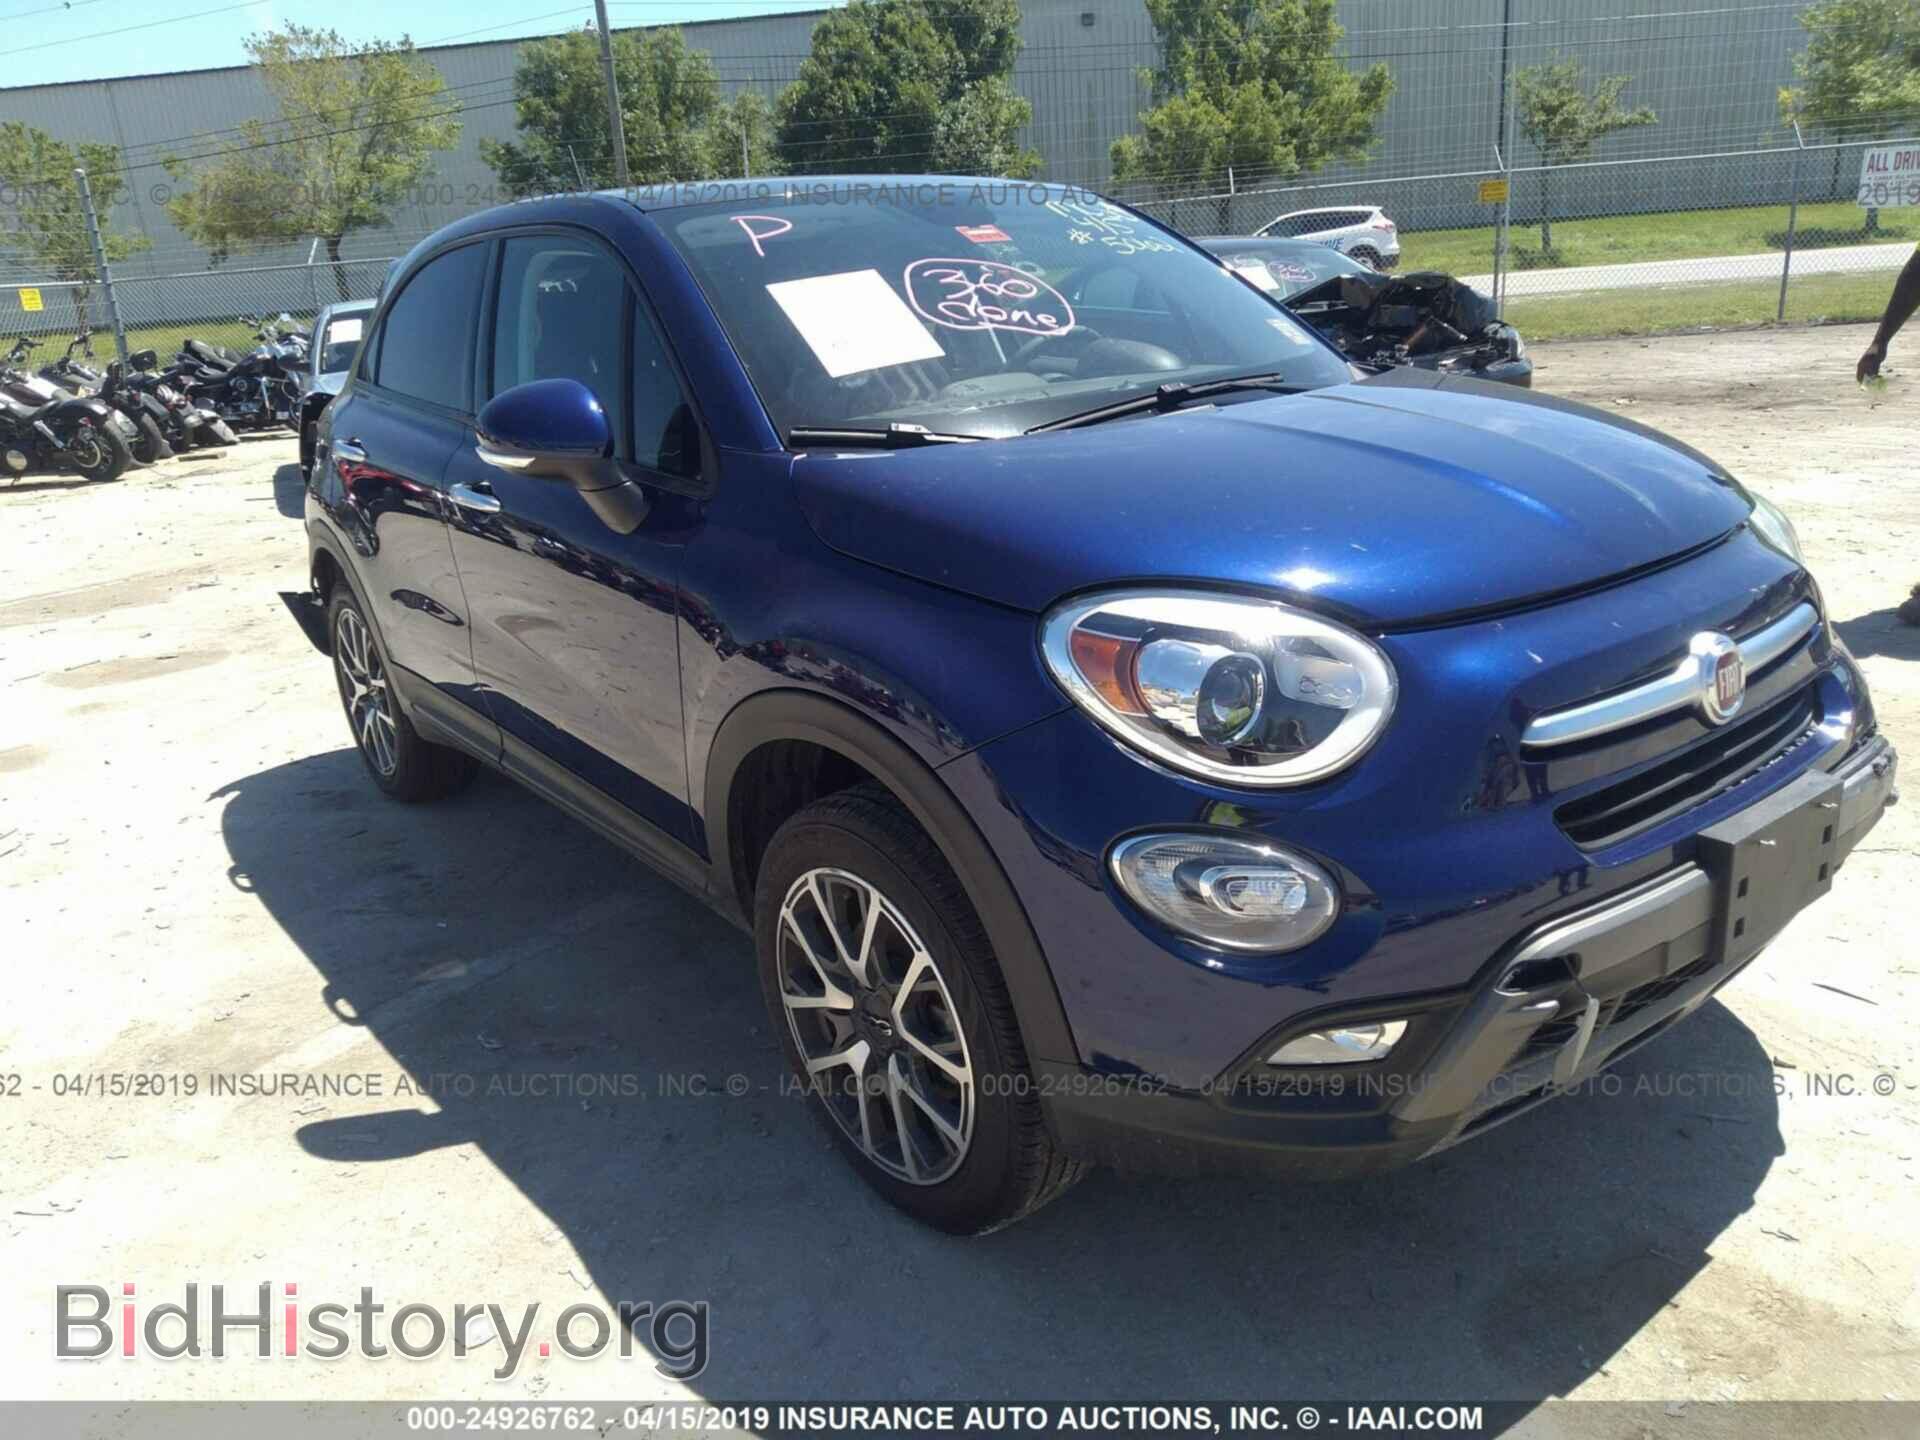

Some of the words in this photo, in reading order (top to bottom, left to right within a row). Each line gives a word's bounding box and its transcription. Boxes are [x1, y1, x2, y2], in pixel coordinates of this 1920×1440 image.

[1867, 153, 1889, 174] ALL
[729, 215, 793, 257] P
[1719, 661, 1741, 701] FIAT
